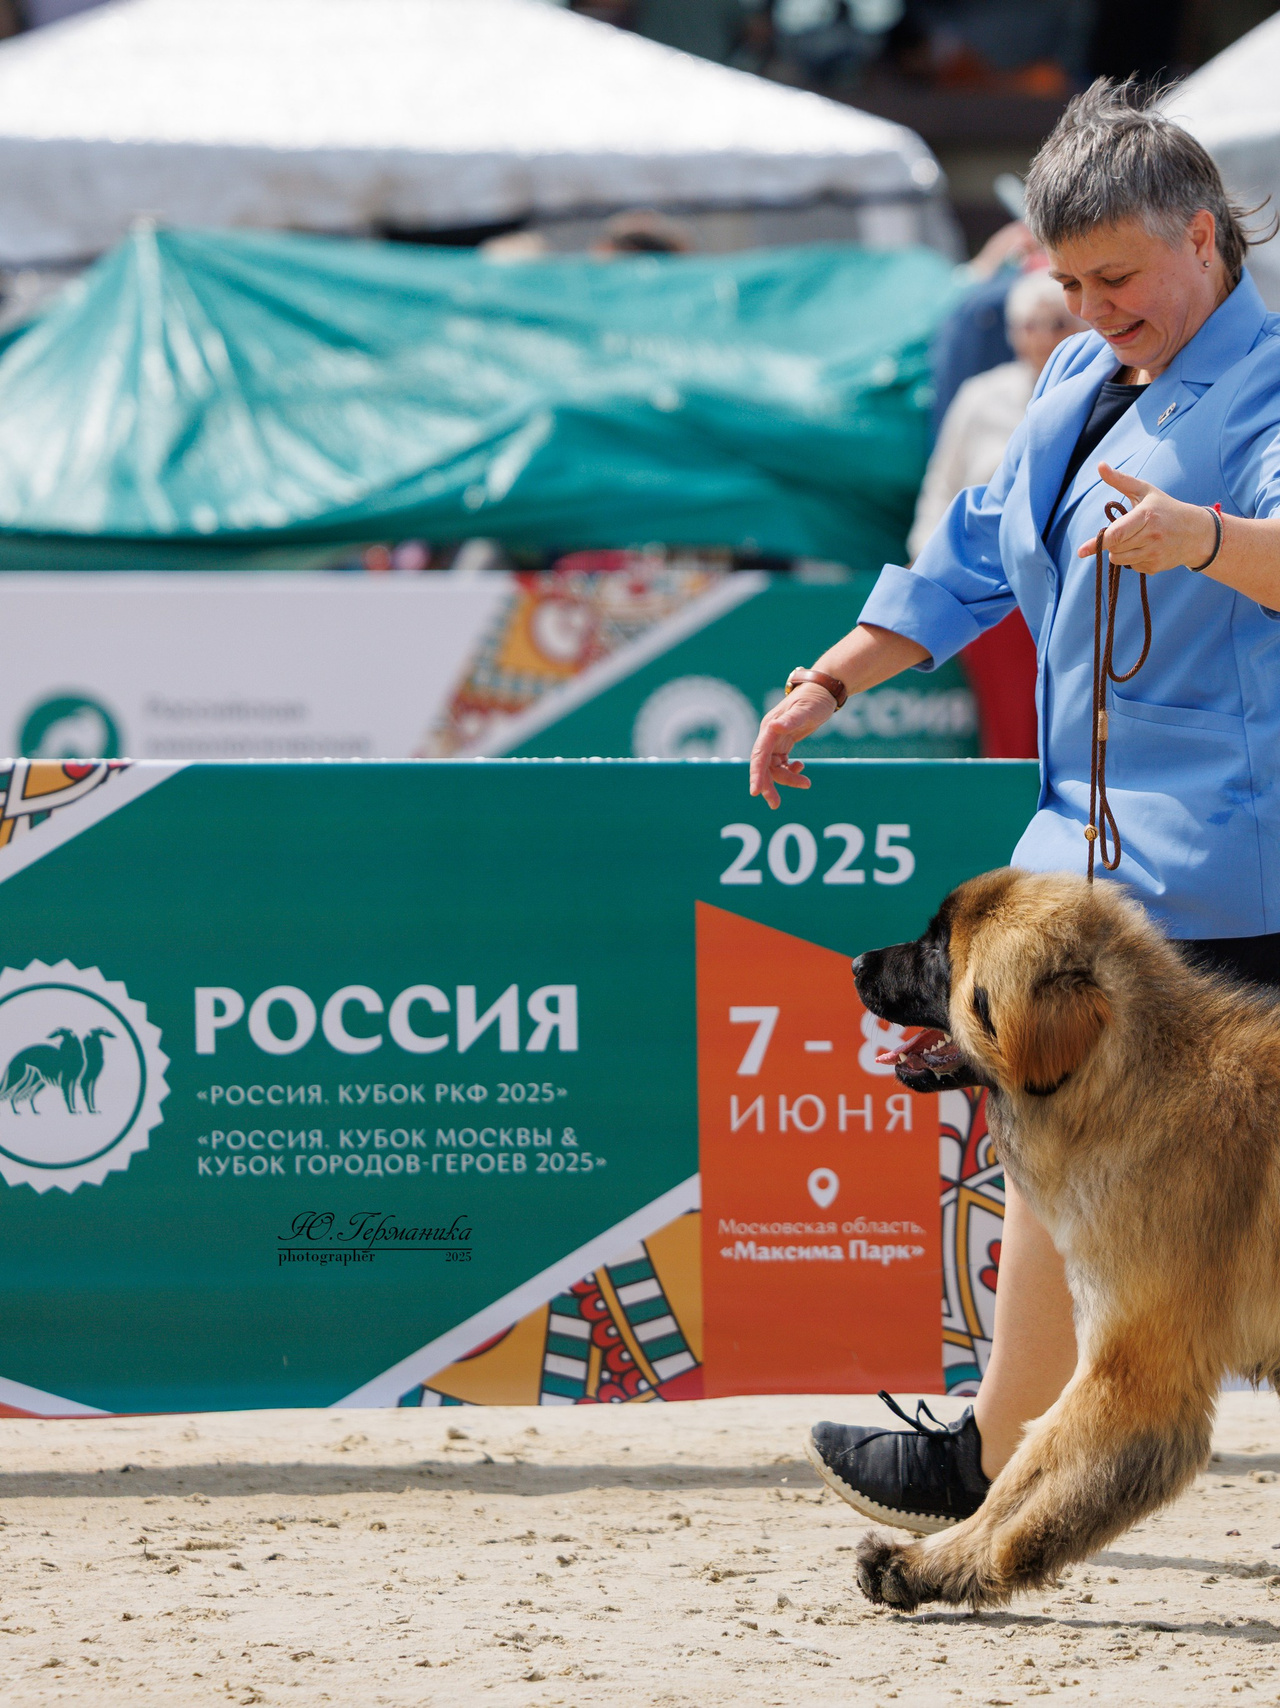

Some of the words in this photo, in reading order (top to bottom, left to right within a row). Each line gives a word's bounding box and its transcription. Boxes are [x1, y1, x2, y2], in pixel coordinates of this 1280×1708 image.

[719, 822, 916, 886] 2025
[194, 983, 580, 1056] РОССИЯ
[728, 1005, 781, 1076] 7
[804, 1039, 834, 1052] -
[857, 1006, 907, 1076] 8
[196, 1084, 330, 1107] «РОССИЯ.
[338, 1083, 427, 1105] КУБОК
[434, 1082, 490, 1105] РКФ
[495, 1081, 569, 1103] 2025»
[730, 1093, 914, 1134] ИЮНЯ
[196, 1128, 331, 1151] «РОССИЯ.
[338, 1127, 428, 1150] КУБОК
[434, 1126, 553, 1149] МОСКВЫ
[560, 1127, 580, 1148] &
[197, 1155, 287, 1177] КУБОК
[294, 1152, 528, 1178] ГОРОДОВ-ГЕРОЕВ
[534, 1151, 608, 1174] 2025»
[717, 1217, 837, 1236] Московская
[719, 1240, 844, 1261] «Максима
[849, 1239, 926, 1265] Парк»
